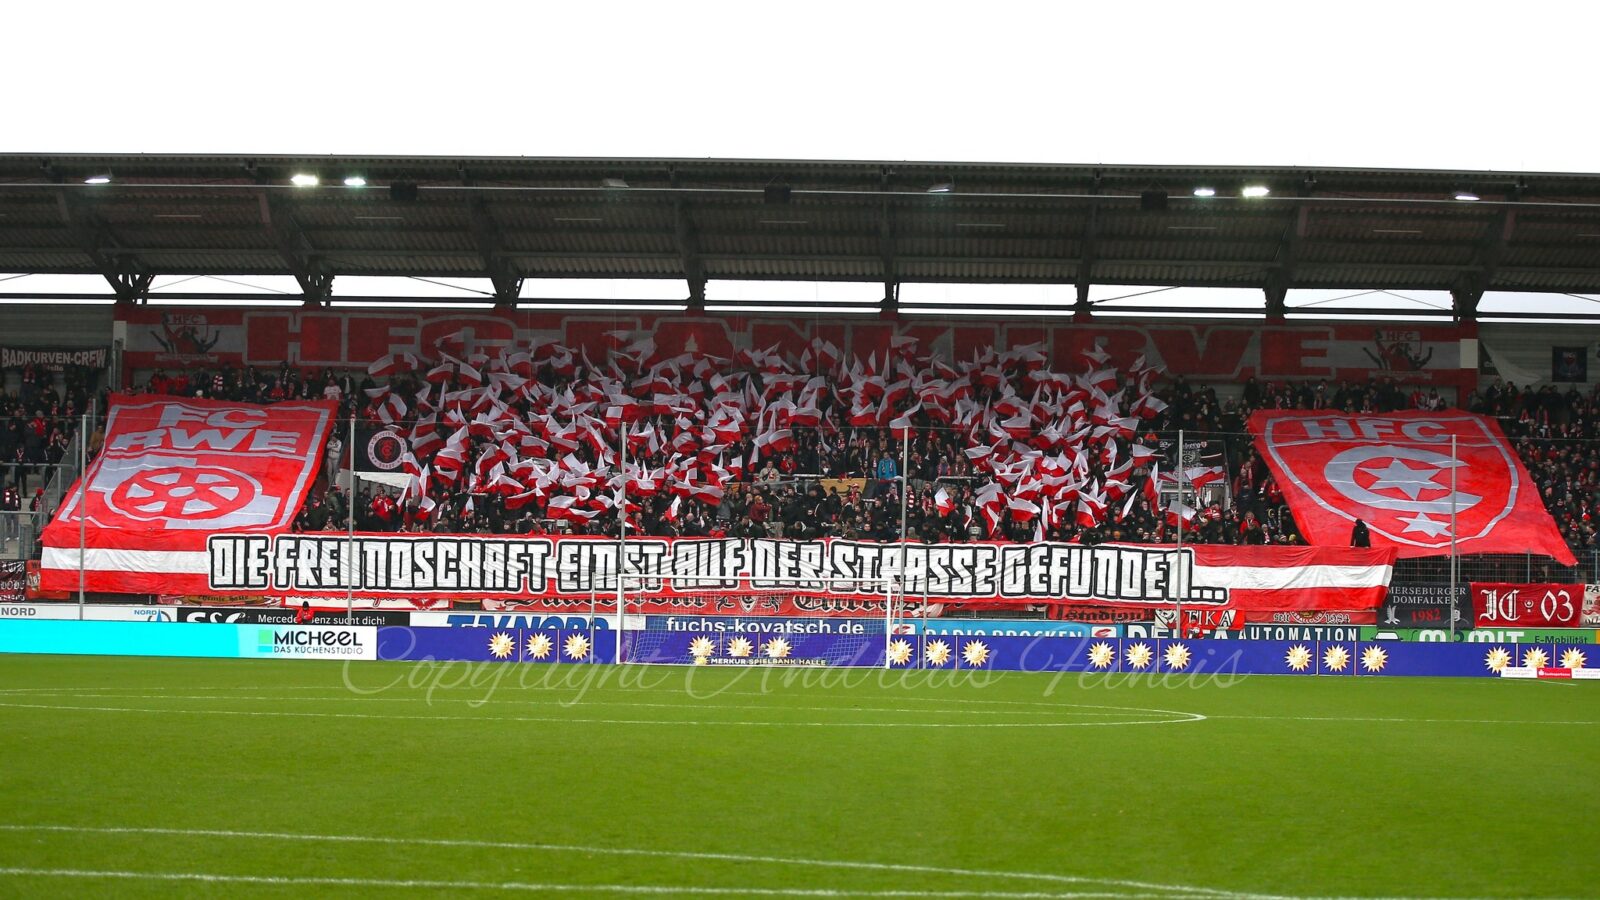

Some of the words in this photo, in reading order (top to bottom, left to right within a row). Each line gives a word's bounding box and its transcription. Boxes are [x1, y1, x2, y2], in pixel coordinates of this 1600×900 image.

[157, 405, 269, 428] FC
[1302, 420, 1453, 443] HFC
[109, 427, 302, 453] RWE
[209, 536, 269, 588] DIE
[274, 537, 552, 593] FREUNDSCHAFT
[556, 540, 666, 593] EINST
[672, 540, 746, 590] AUF
[751, 541, 825, 591] DER
[830, 543, 998, 597] STRASSE
[1387, 586, 1466, 596] MERSEBURGER
[1393, 595, 1459, 605] DOMFALKEN
[1540, 589, 1574, 622] 03
[1, 607, 36, 616] NORD
[1411, 609, 1441, 622] 1982
[362, 616, 386, 625] dich!
[666, 617, 864, 635] fuchs-kovatsch.de
[1534, 635, 1587, 644] E-Mobilität
[294, 645, 363, 655] KÜCHENSTUDIO
[749, 658, 796, 666] SPIELBANK
